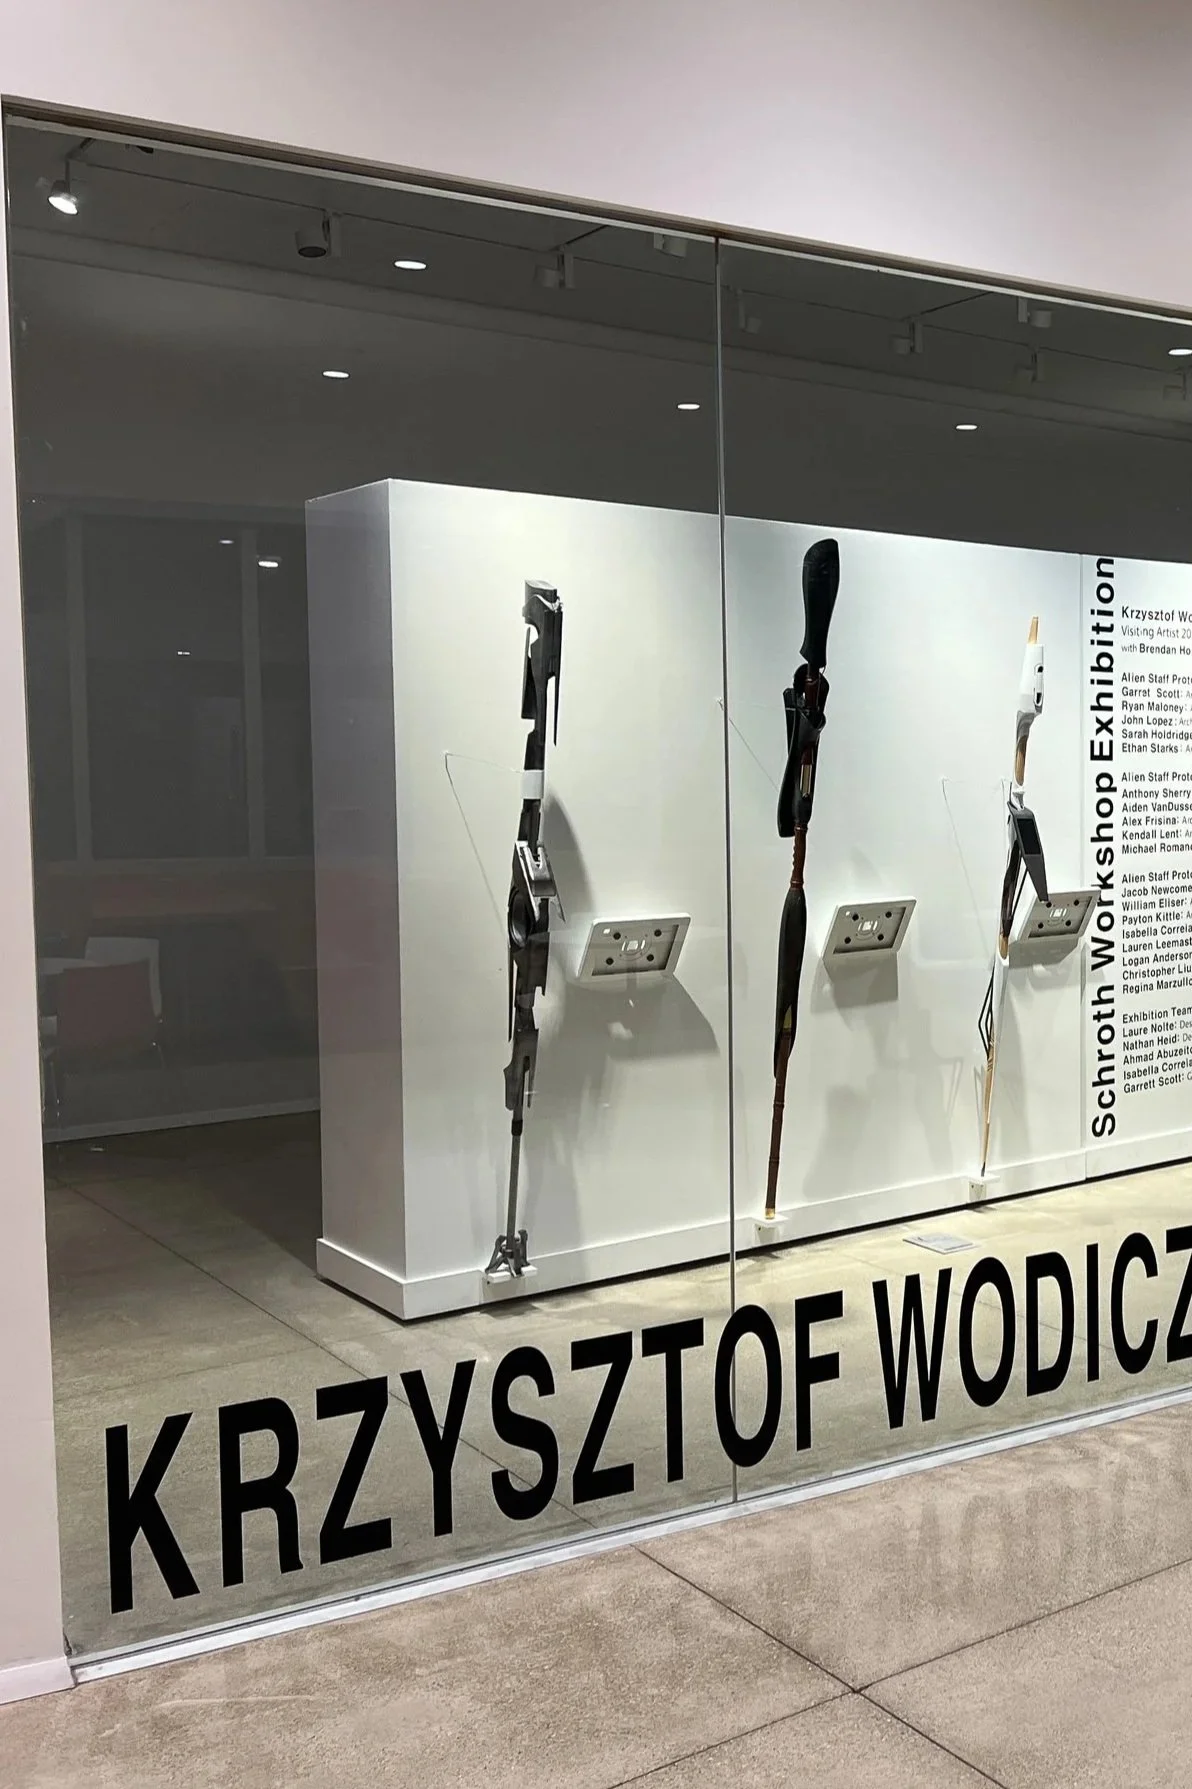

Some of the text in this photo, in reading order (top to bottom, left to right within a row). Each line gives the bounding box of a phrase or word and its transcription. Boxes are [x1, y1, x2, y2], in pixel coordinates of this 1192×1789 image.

[1121, 606, 1175, 622] Krzysztof
[1121, 626, 1154, 639] Visiting
[1157, 627, 1179, 638] Artist
[1121, 644, 1137, 652] with
[1140, 644, 1176, 655] Brendan
[1122, 672, 1145, 683] Alien
[1148, 674, 1169, 684] Staff
[1122, 701, 1144, 712] Ryan
[1122, 715, 1143, 725] John
[1122, 728, 1148, 739] Sarah
[1122, 743, 1147, 753] Ethan
[1122, 772, 1145, 782] Alien
[1148, 772, 1169, 781] Staff
[1122, 789, 1159, 799] Anthony
[1122, 803, 1148, 812] Aiden
[1122, 817, 1142, 826] Alex
[1122, 830, 1156, 840] Kendall
[1160, 830, 1181, 839] Lent:
[1090, 557, 1118, 1138] Schroth Workshop Exhibition
[1122, 843, 1156, 854] Michael
[1122, 874, 1145, 883] Alien
[1149, 871, 1169, 882] Staff
[1122, 888, 1148, 898] Jacob
[1122, 900, 1155, 911] William
[1122, 915, 1153, 925] Payton
[1156, 911, 1183, 922] Kittle:
[1122, 927, 1157, 939] Isabella
[1122, 941, 1153, 953] Lauren
[1122, 955, 1149, 967] Logan
[1123, 967, 1175, 980] Christopher
[1123, 983, 1153, 994] Regina
[1122, 1009, 1168, 1024] Exhibition
[1123, 1025, 1148, 1038] Laure
[1151, 1021, 1177, 1033] Nolte:
[1123, 1038, 1154, 1051] Nathan
[1157, 1033, 1180, 1046] Heid:
[1123, 1051, 1154, 1065] Ahmad
[1123, 1065, 1158, 1080] Isabella
[1123, 1079, 1155, 1093] Garrett
[1158, 1073, 1184, 1086] Scott:
[105, 1290, 843, 1616] KRZYSZTOF
